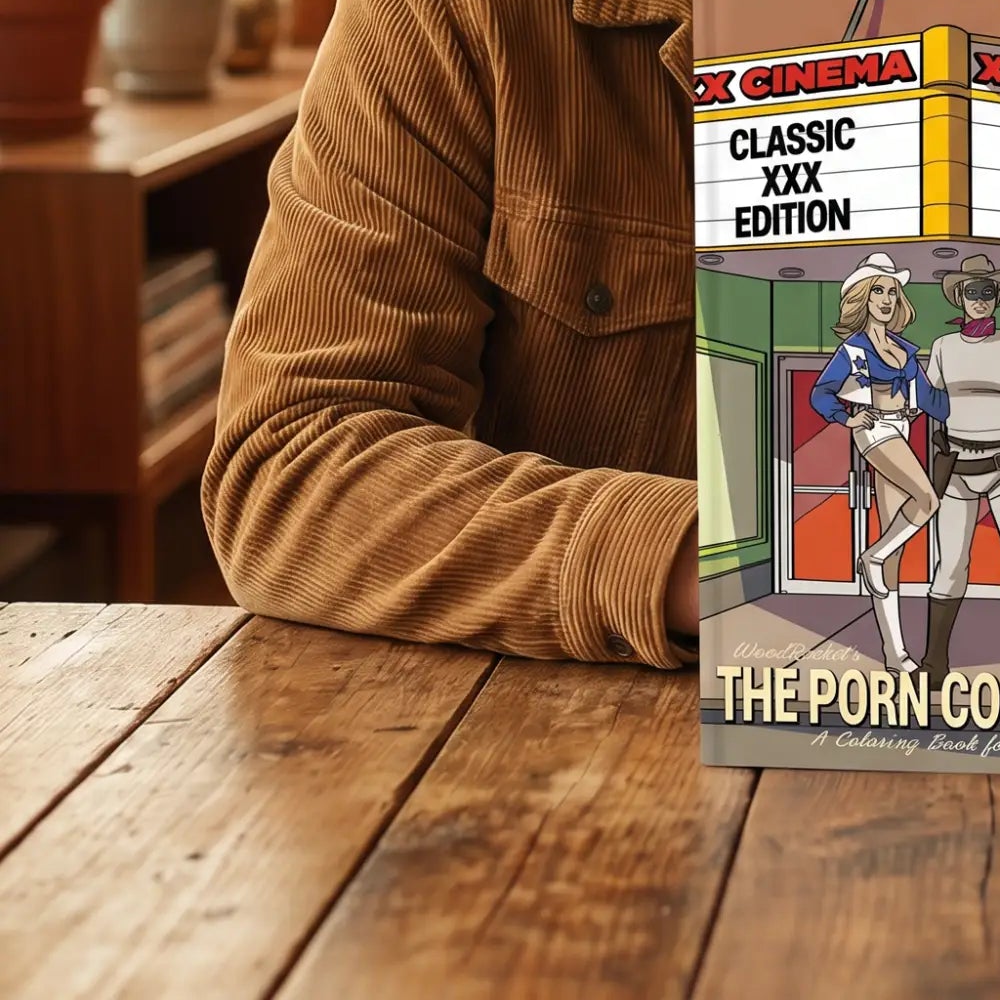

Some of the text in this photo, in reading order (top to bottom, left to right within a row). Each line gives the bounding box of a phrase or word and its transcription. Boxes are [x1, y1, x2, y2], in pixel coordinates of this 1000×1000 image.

[693, 49, 916, 105] X CINEMA
[730, 117, 856, 161] CLASSIC
[762, 161, 823, 197] XXX
[734, 198, 851, 238] EDITION
[716, 666, 800, 724] THE
[809, 668, 931, 728] PORN
[811, 730, 829, 746] A
[835, 731, 919, 756] Coloring
[927, 734, 978, 751] Book
